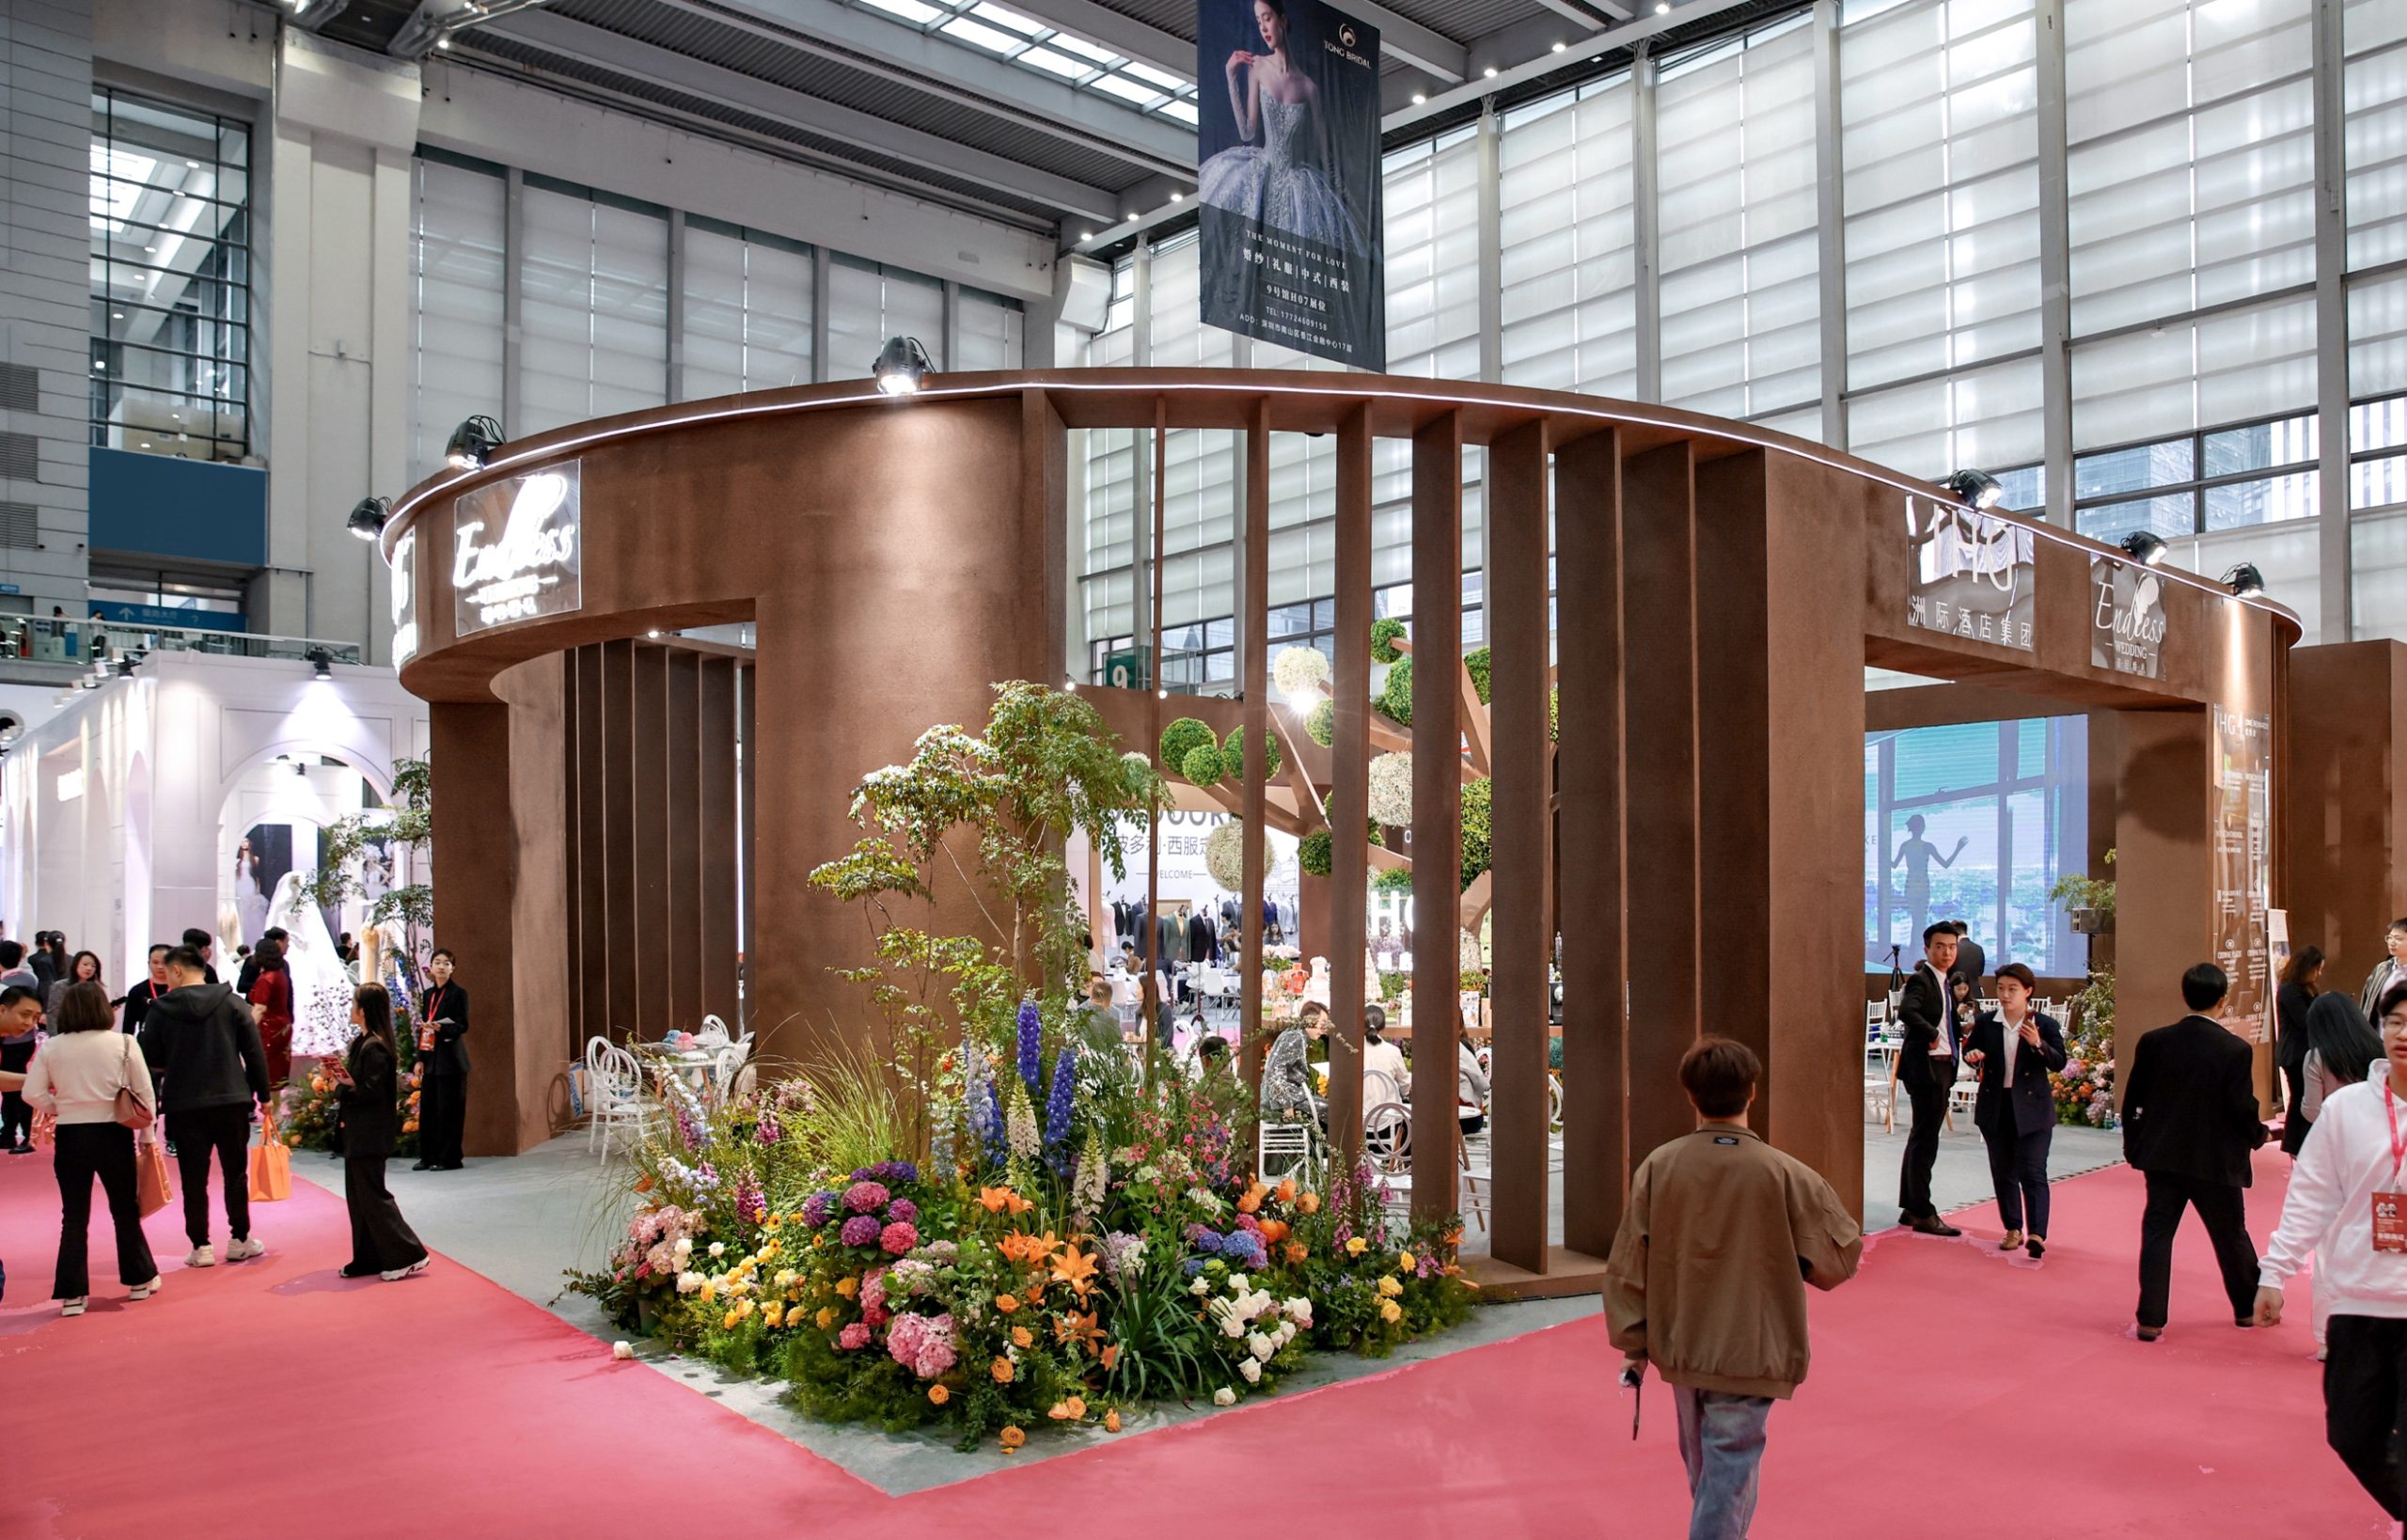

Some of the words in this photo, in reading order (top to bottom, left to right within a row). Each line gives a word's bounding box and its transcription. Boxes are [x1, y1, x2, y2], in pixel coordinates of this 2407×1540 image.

[1324, 39, 1345, 56] TONG
[1346, 51, 1372, 70] BRIDAL
[1246, 229, 1263, 242] THE
[1266, 238, 1302, 255] MOMENT
[1306, 249, 1321, 262] FOR
[1326, 257, 1346, 269] LOVE
[1933, 504, 2013, 591] IHG
[1911, 595, 2032, 647] 洲际酒店集团
[2096, 573, 2163, 643] Endless
[2114, 640, 2147, 658] WEDDING
[1156, 870, 1192, 879] ELCOME
